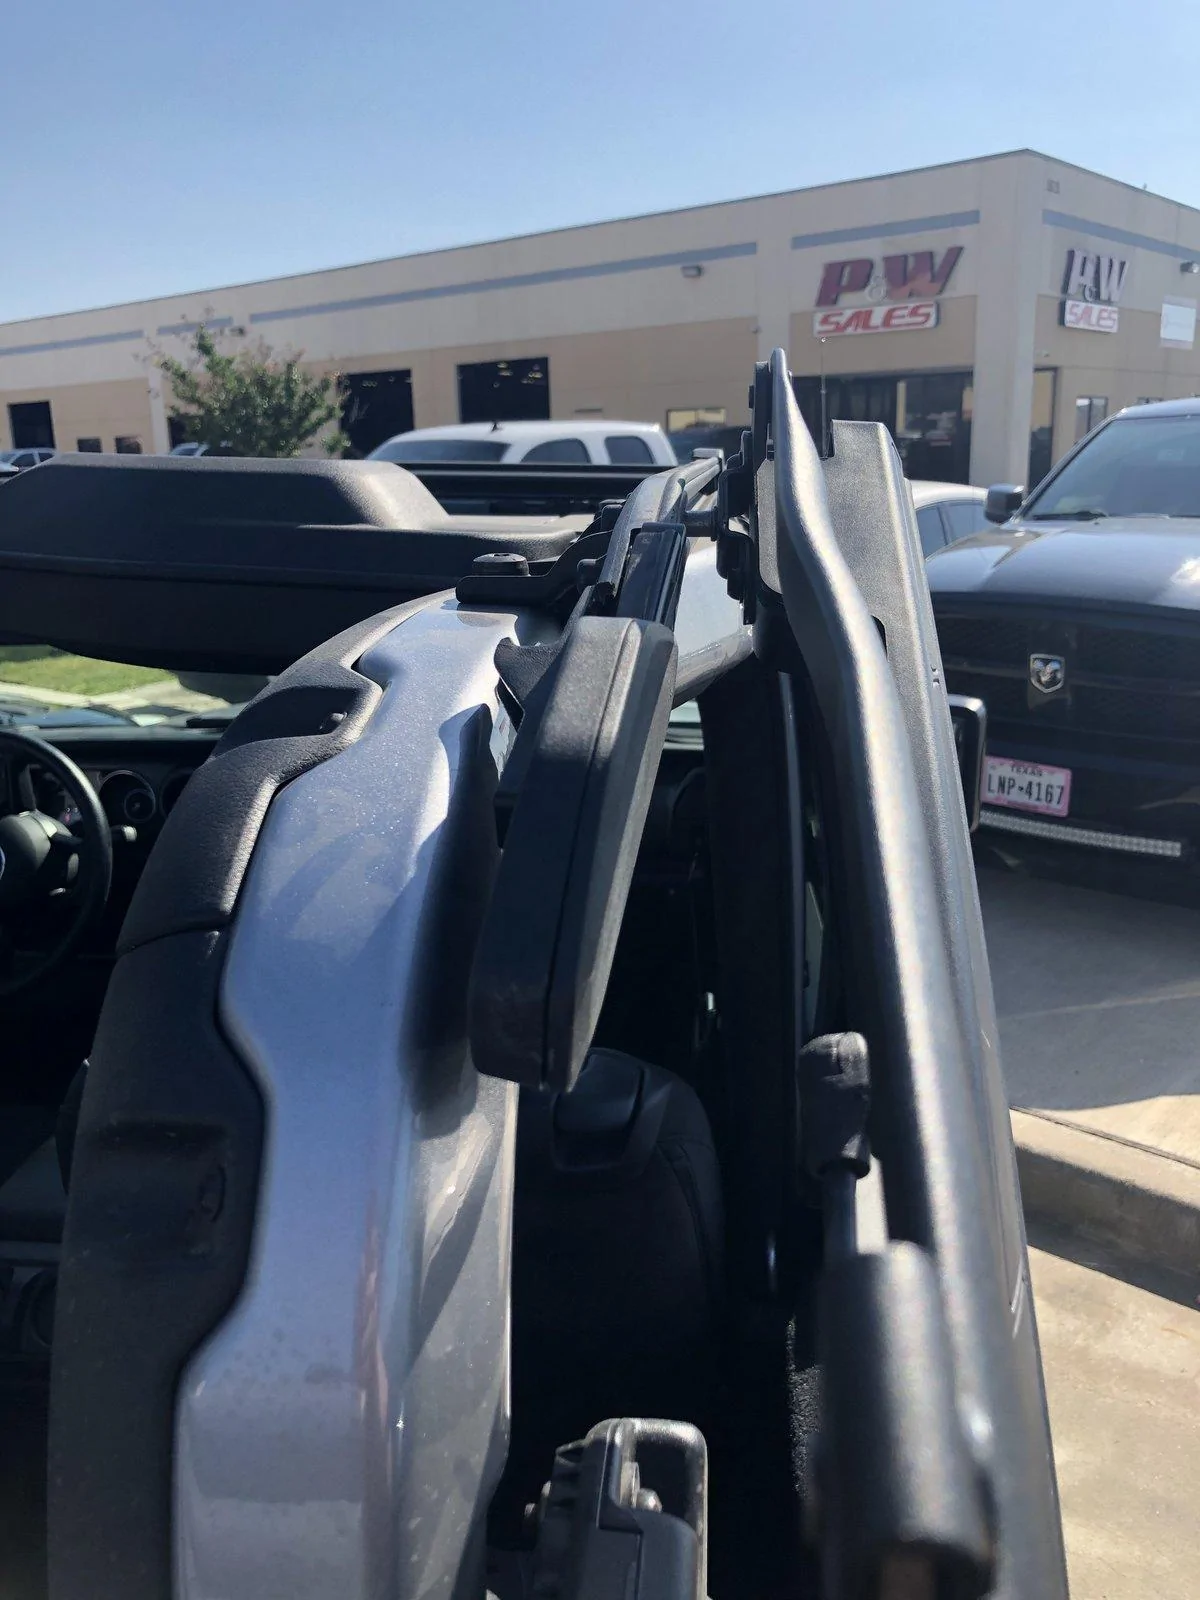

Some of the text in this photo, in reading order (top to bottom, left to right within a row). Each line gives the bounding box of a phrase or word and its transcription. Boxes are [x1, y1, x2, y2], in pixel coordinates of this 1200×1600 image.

[817, 303, 935, 336] SALES
[1067, 303, 1118, 330] SALES
[1010, 764, 1043, 777] TEXAS
